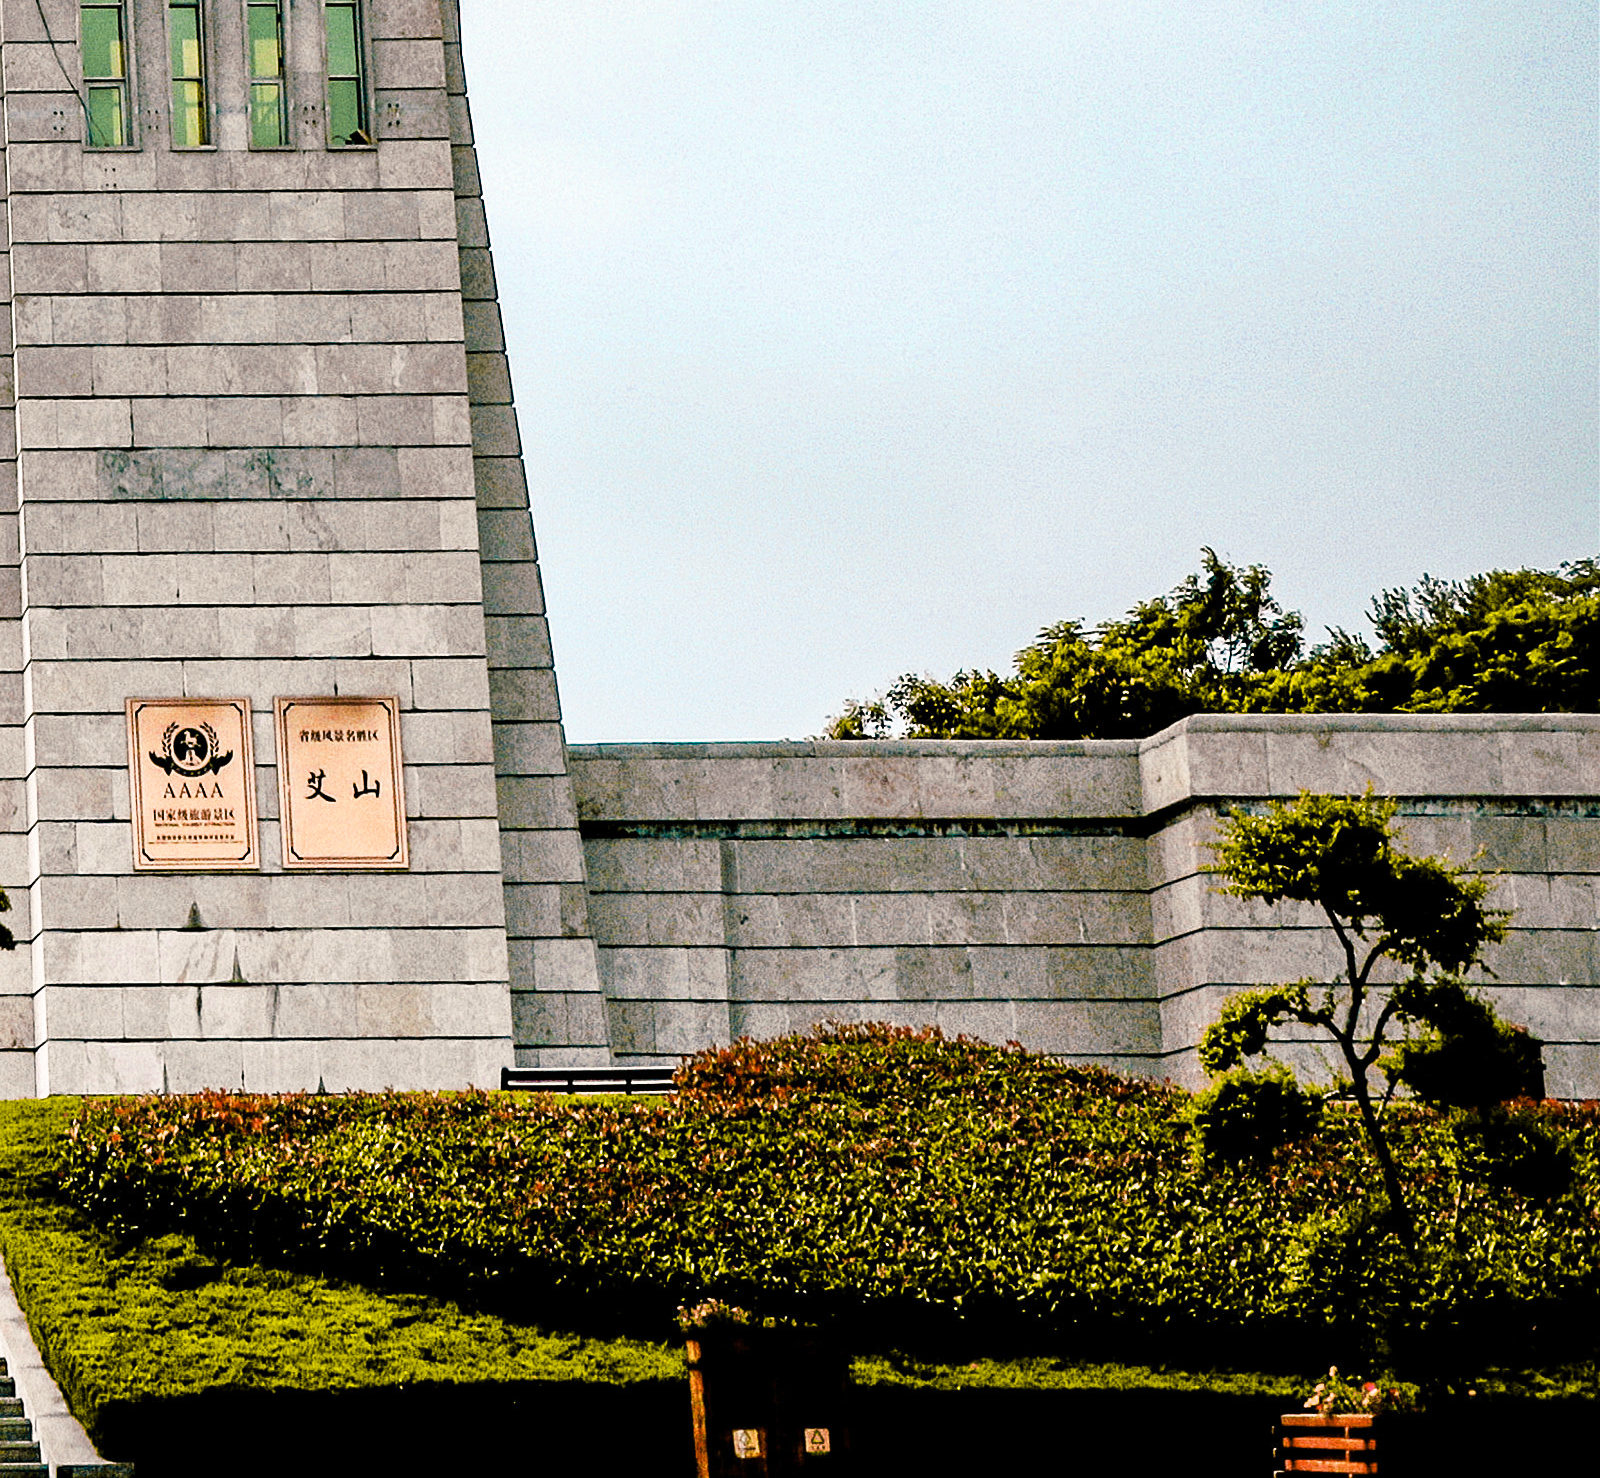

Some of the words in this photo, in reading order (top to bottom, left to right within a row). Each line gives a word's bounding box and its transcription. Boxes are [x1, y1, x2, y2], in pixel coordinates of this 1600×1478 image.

[299, 729, 380, 743] 省级风景名胜区
[163, 782, 225, 799] AAAA
[305, 768, 381, 803] 艾山
[152, 807, 236, 822] 国家级旅游景区
